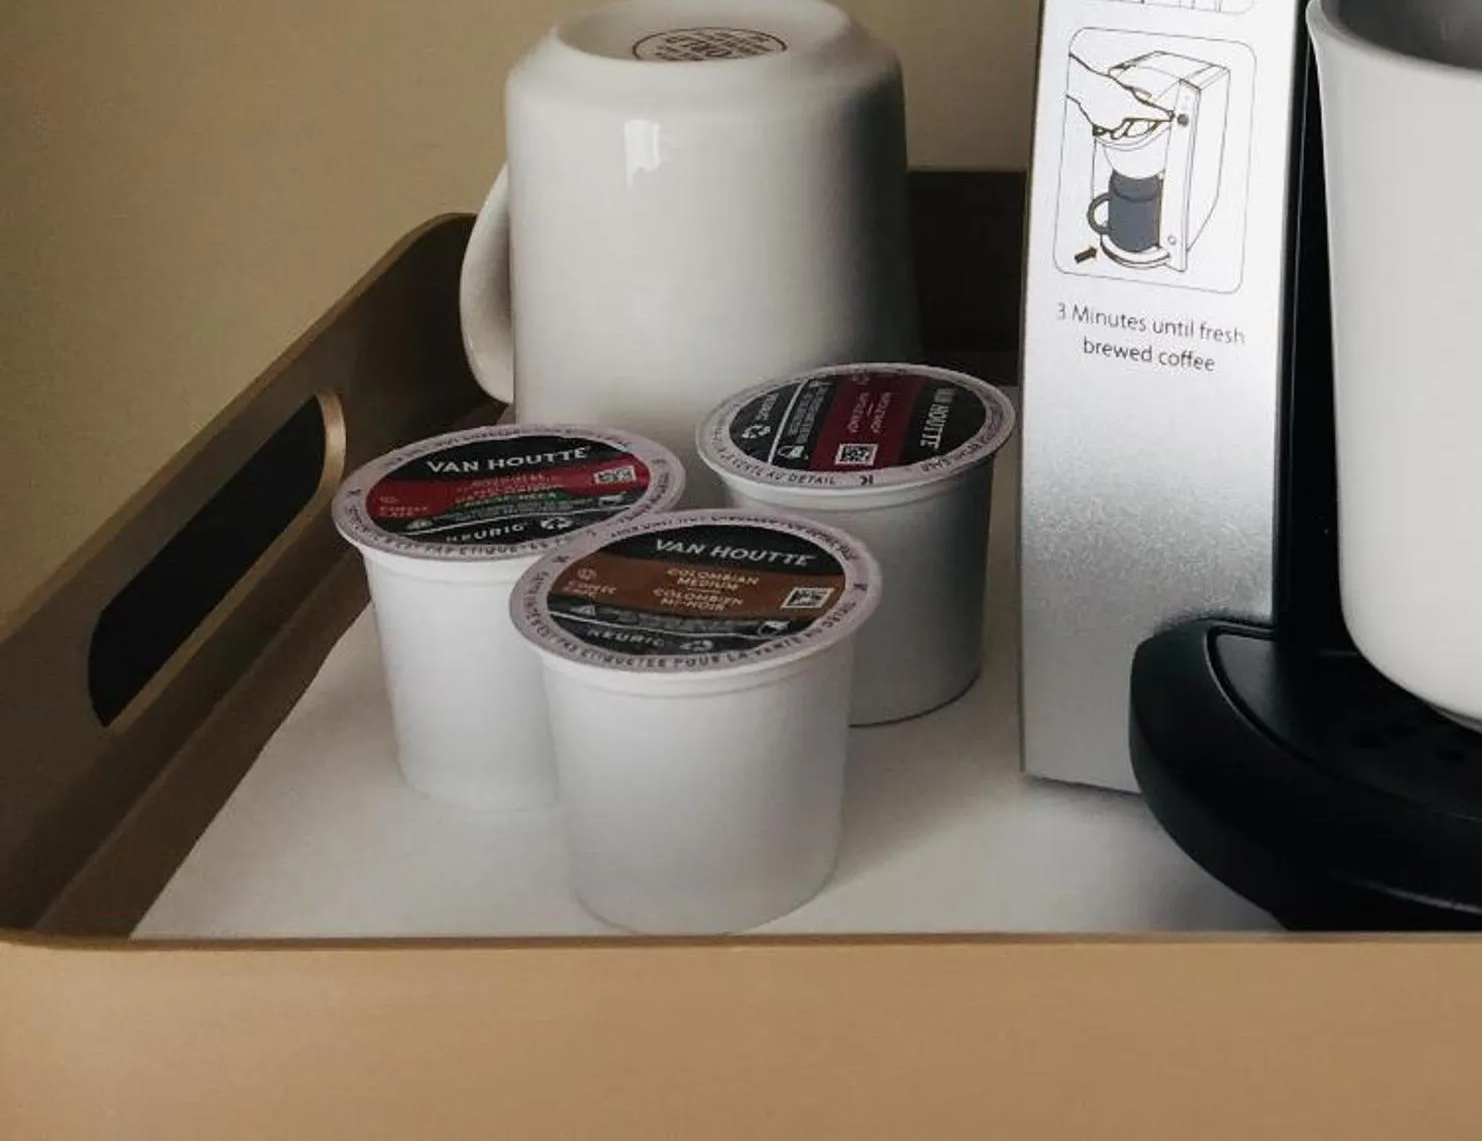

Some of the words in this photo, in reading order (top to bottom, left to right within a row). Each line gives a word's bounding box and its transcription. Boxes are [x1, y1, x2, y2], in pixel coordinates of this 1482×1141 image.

[1057, 302, 1066, 321] 3
[1071, 304, 1146, 332] Minutes
[1152, 319, 1194, 338] until
[1199, 322, 1246, 344] fresh
[1083, 335, 1152, 363] brewed
[1158, 350, 1215, 372] coffee
[426, 460, 479, 473] VAN
[488, 447, 587, 470] HOUTTE
[655, 539, 708, 557] VAN
[711, 545, 818, 567] HOUTTE
[665, 568, 760, 585] COLOMBIAN
[676, 577, 739, 591] MEDIUM
[652, 588, 744, 605] COLOMBIEN
